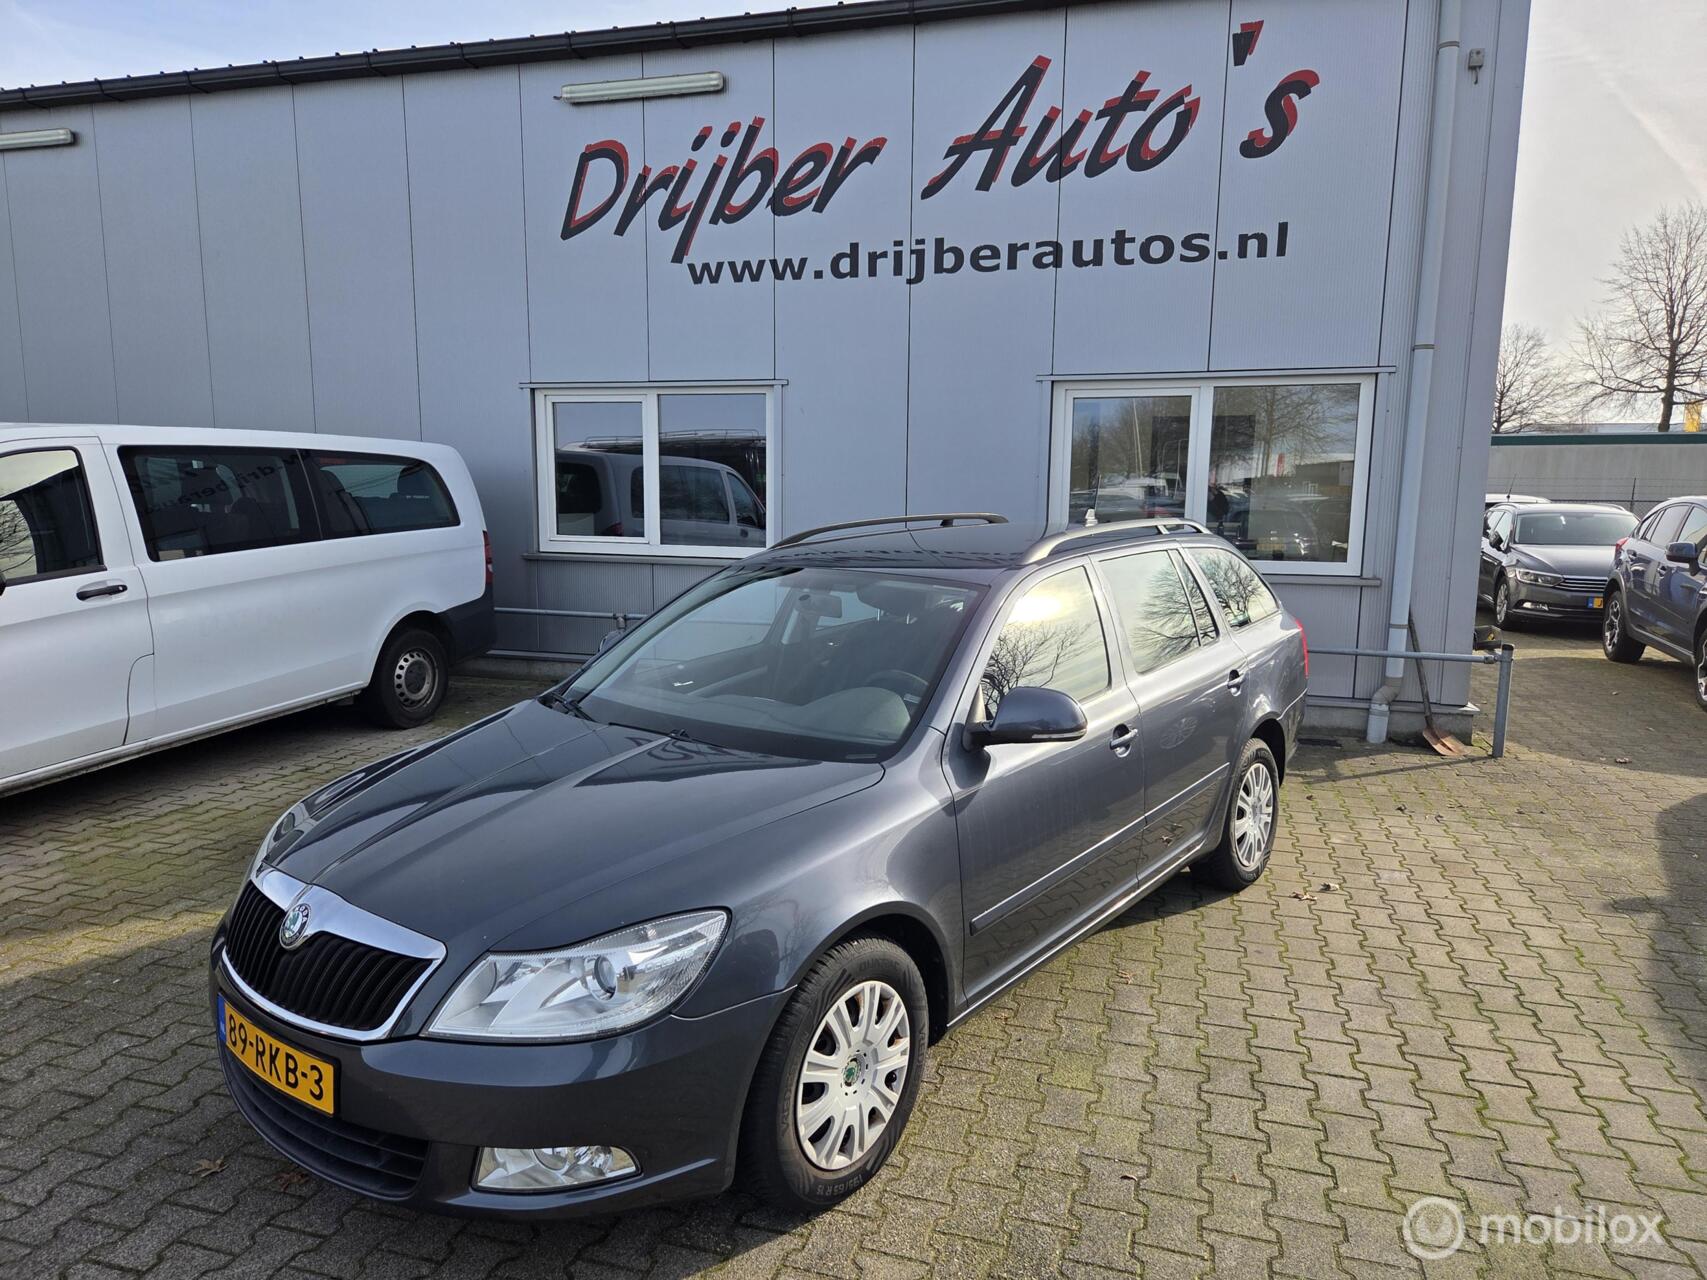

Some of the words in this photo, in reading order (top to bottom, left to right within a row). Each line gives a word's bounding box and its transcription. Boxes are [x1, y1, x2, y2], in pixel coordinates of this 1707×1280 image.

[560, 116, 888, 264] Drijber
[920, 19, 1320, 201] Auto's
[686, 221, 1289, 286] www.drijberautos.nl
[228, 1012, 325, 1102] 89-RKB-3
